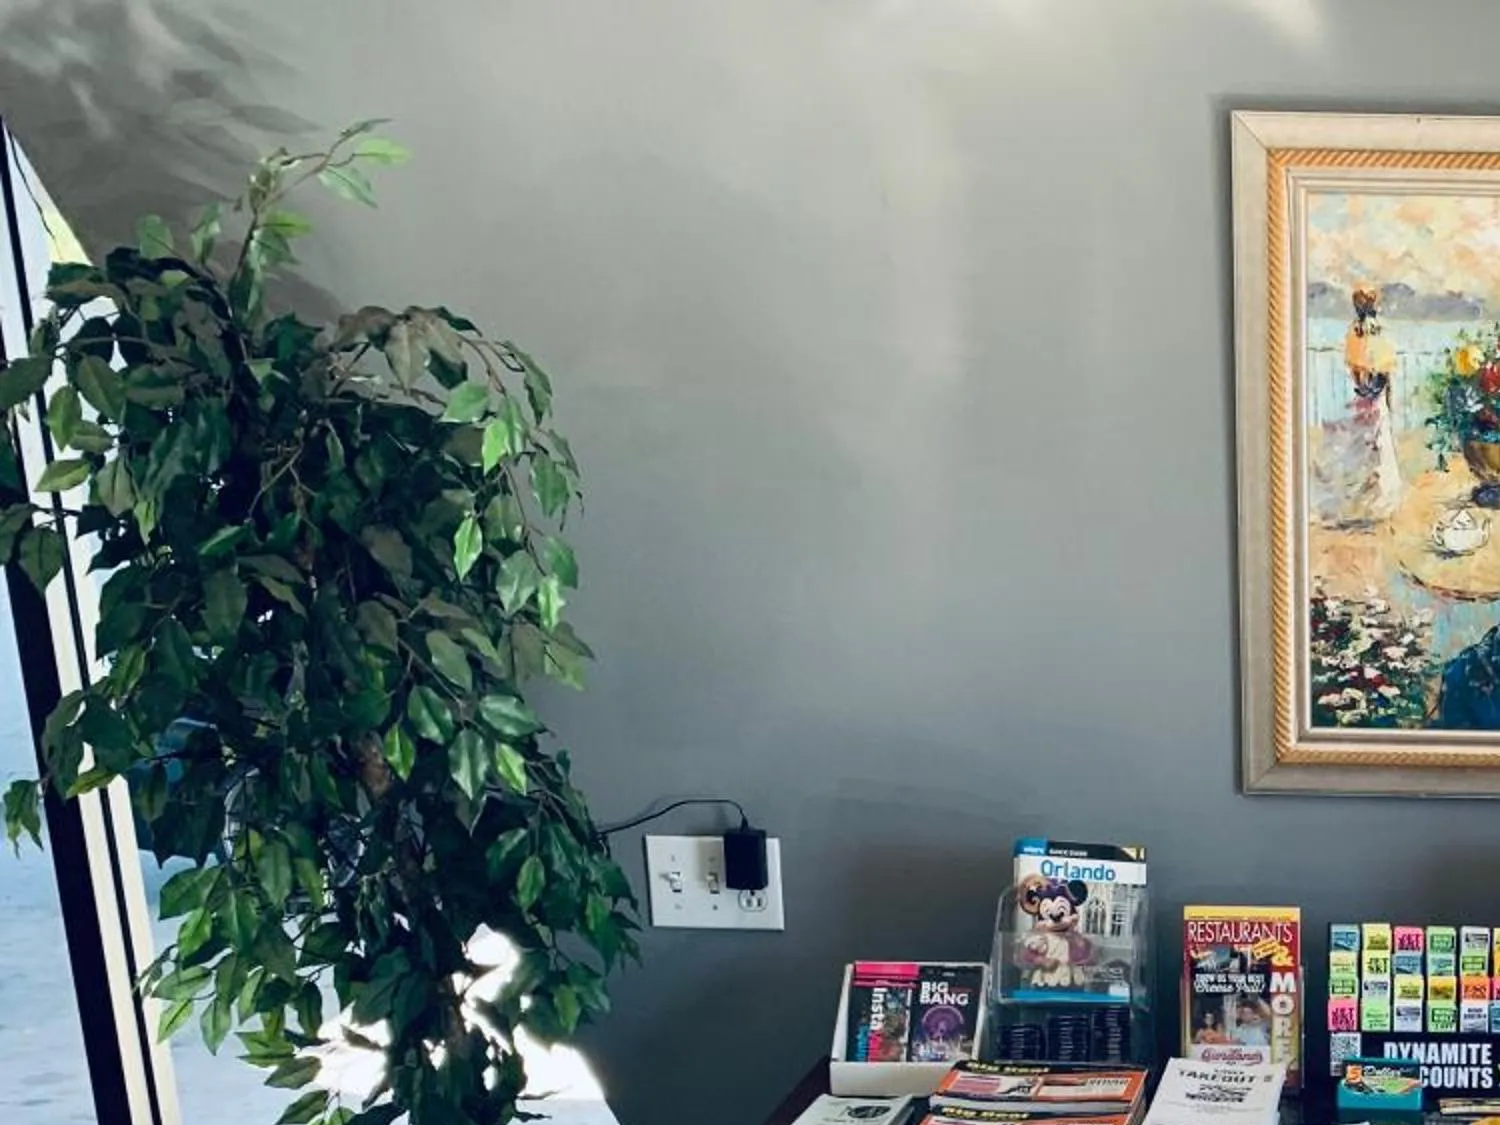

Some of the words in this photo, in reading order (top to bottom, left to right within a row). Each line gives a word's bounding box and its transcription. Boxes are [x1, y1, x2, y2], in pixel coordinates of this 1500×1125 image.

[1041, 860, 1116, 881] Orlando
[1187, 922, 1293, 943] RESTAURANTS
[921, 982, 948, 993] BIG
[920, 993, 968, 1005] BANG
[1384, 1042, 1493, 1065] DYNAMITE
[1419, 1066, 1493, 1088] COUNTS
